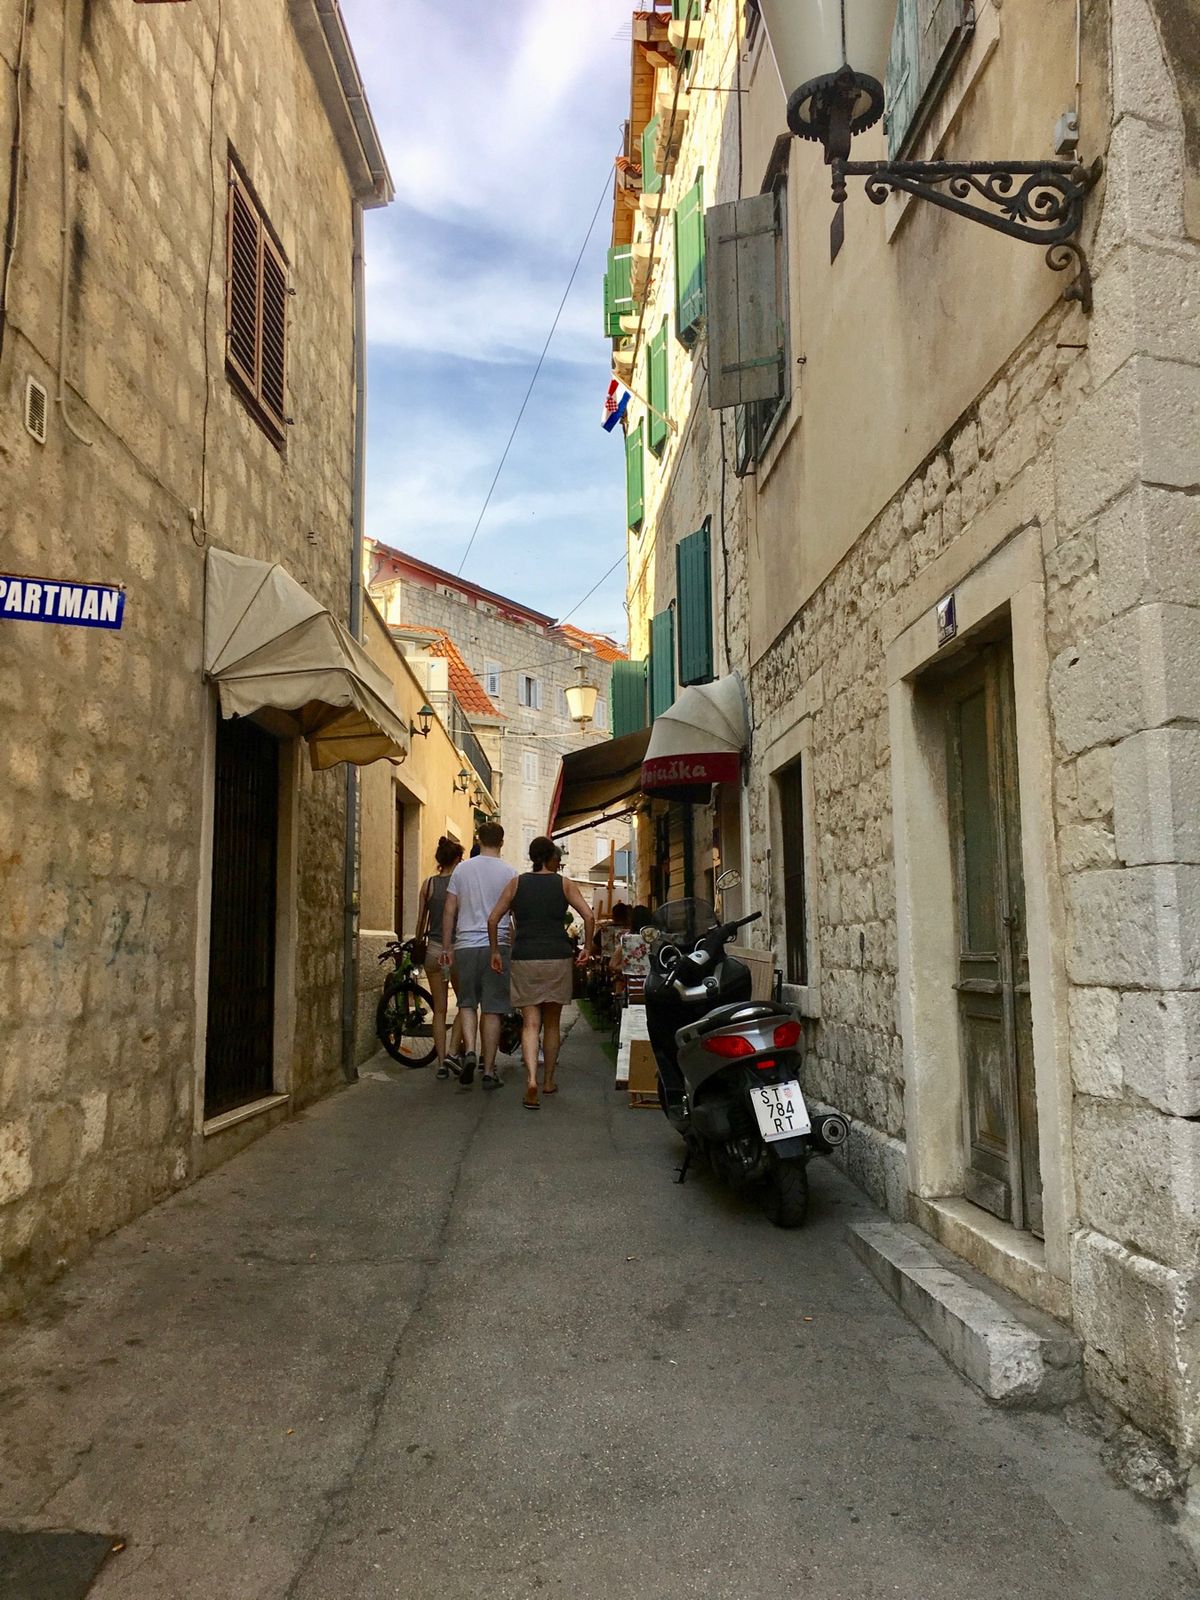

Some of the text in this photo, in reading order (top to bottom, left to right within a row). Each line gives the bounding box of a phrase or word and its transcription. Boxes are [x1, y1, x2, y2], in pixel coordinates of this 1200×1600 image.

[760, 1087, 779, 1104] ST
[767, 1100, 795, 1118] 784
[773, 1115, 793, 1132] RT
